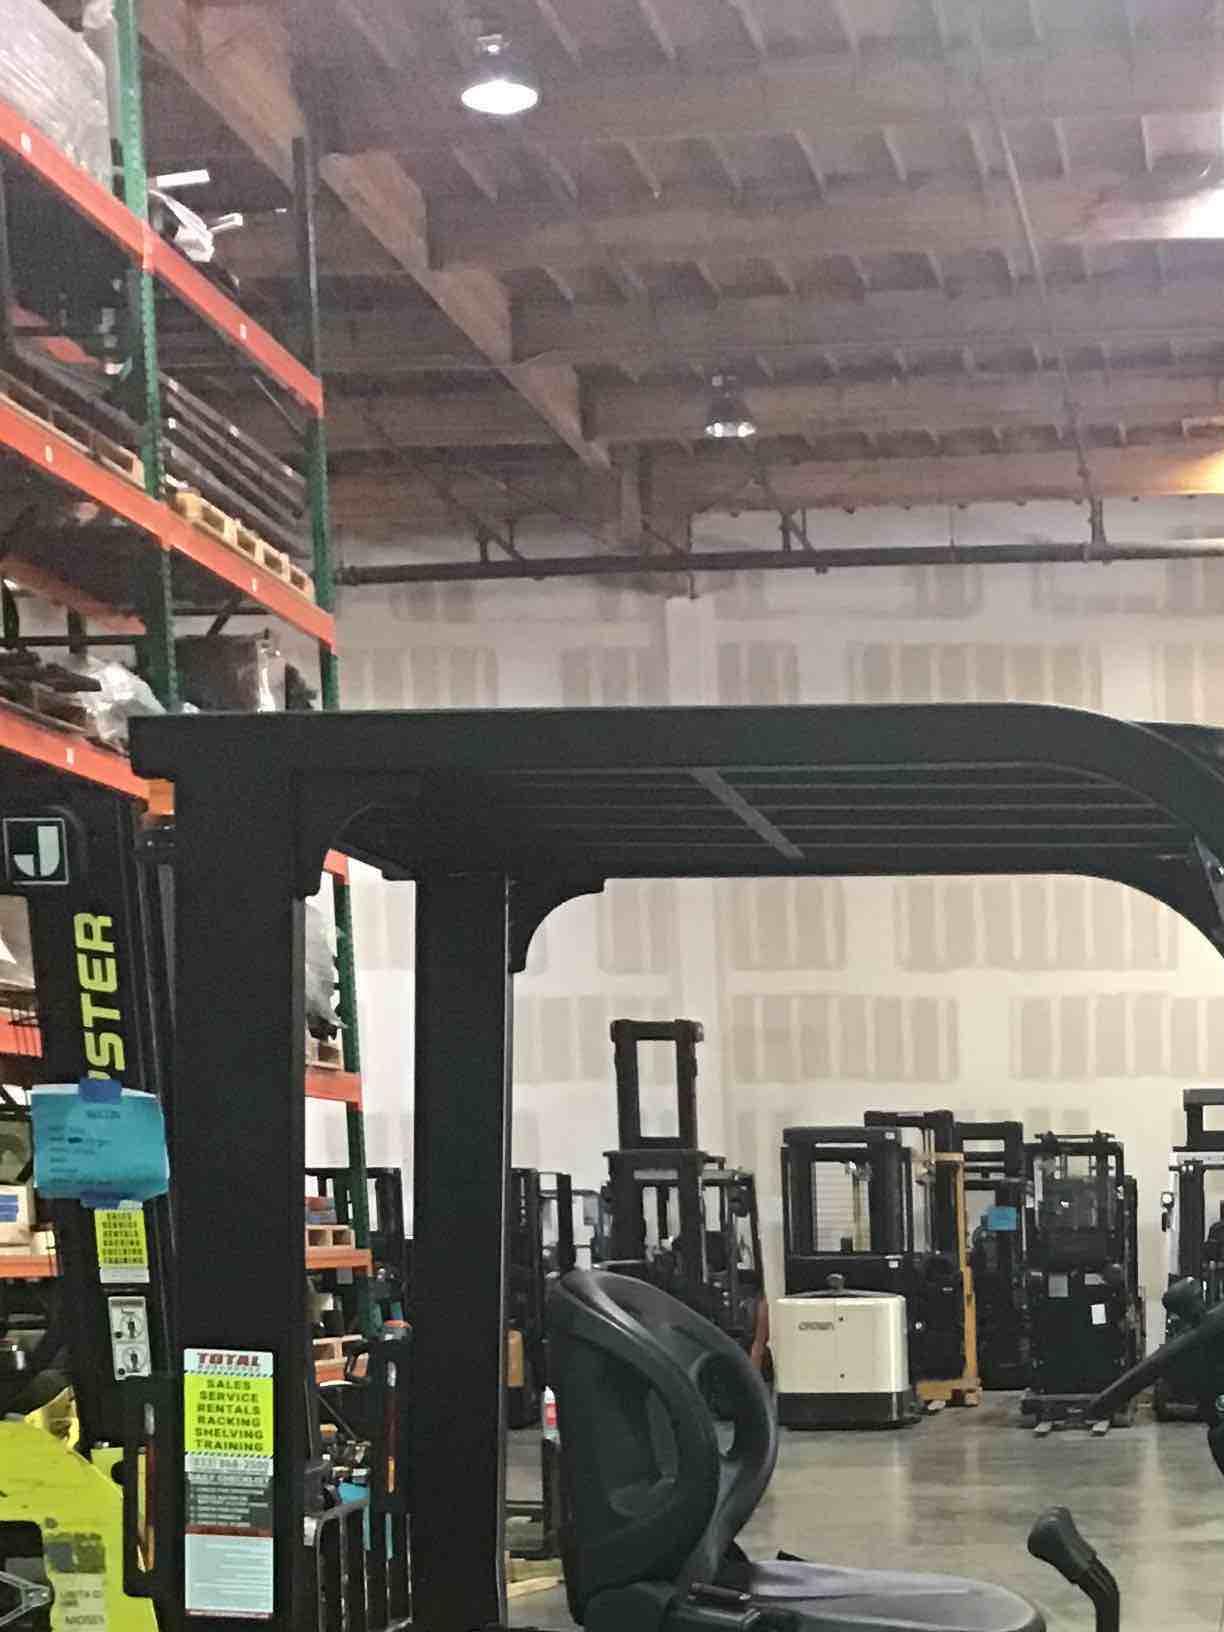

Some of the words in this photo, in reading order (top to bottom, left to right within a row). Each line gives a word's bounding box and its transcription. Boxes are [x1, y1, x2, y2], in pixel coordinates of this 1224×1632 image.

[73, 912, 126, 1081] STER
[197, 1353, 261, 1367] TOTAL
[206, 1380, 252, 1390] SALES
[199, 1391, 259, 1403] SERVICE
[197, 1403, 261, 1415] RENTALS
[197, 1415, 261, 1428] RACKING
[195, 1427, 264, 1439] SHELVING
[195, 1440, 264, 1451] TRAINING
